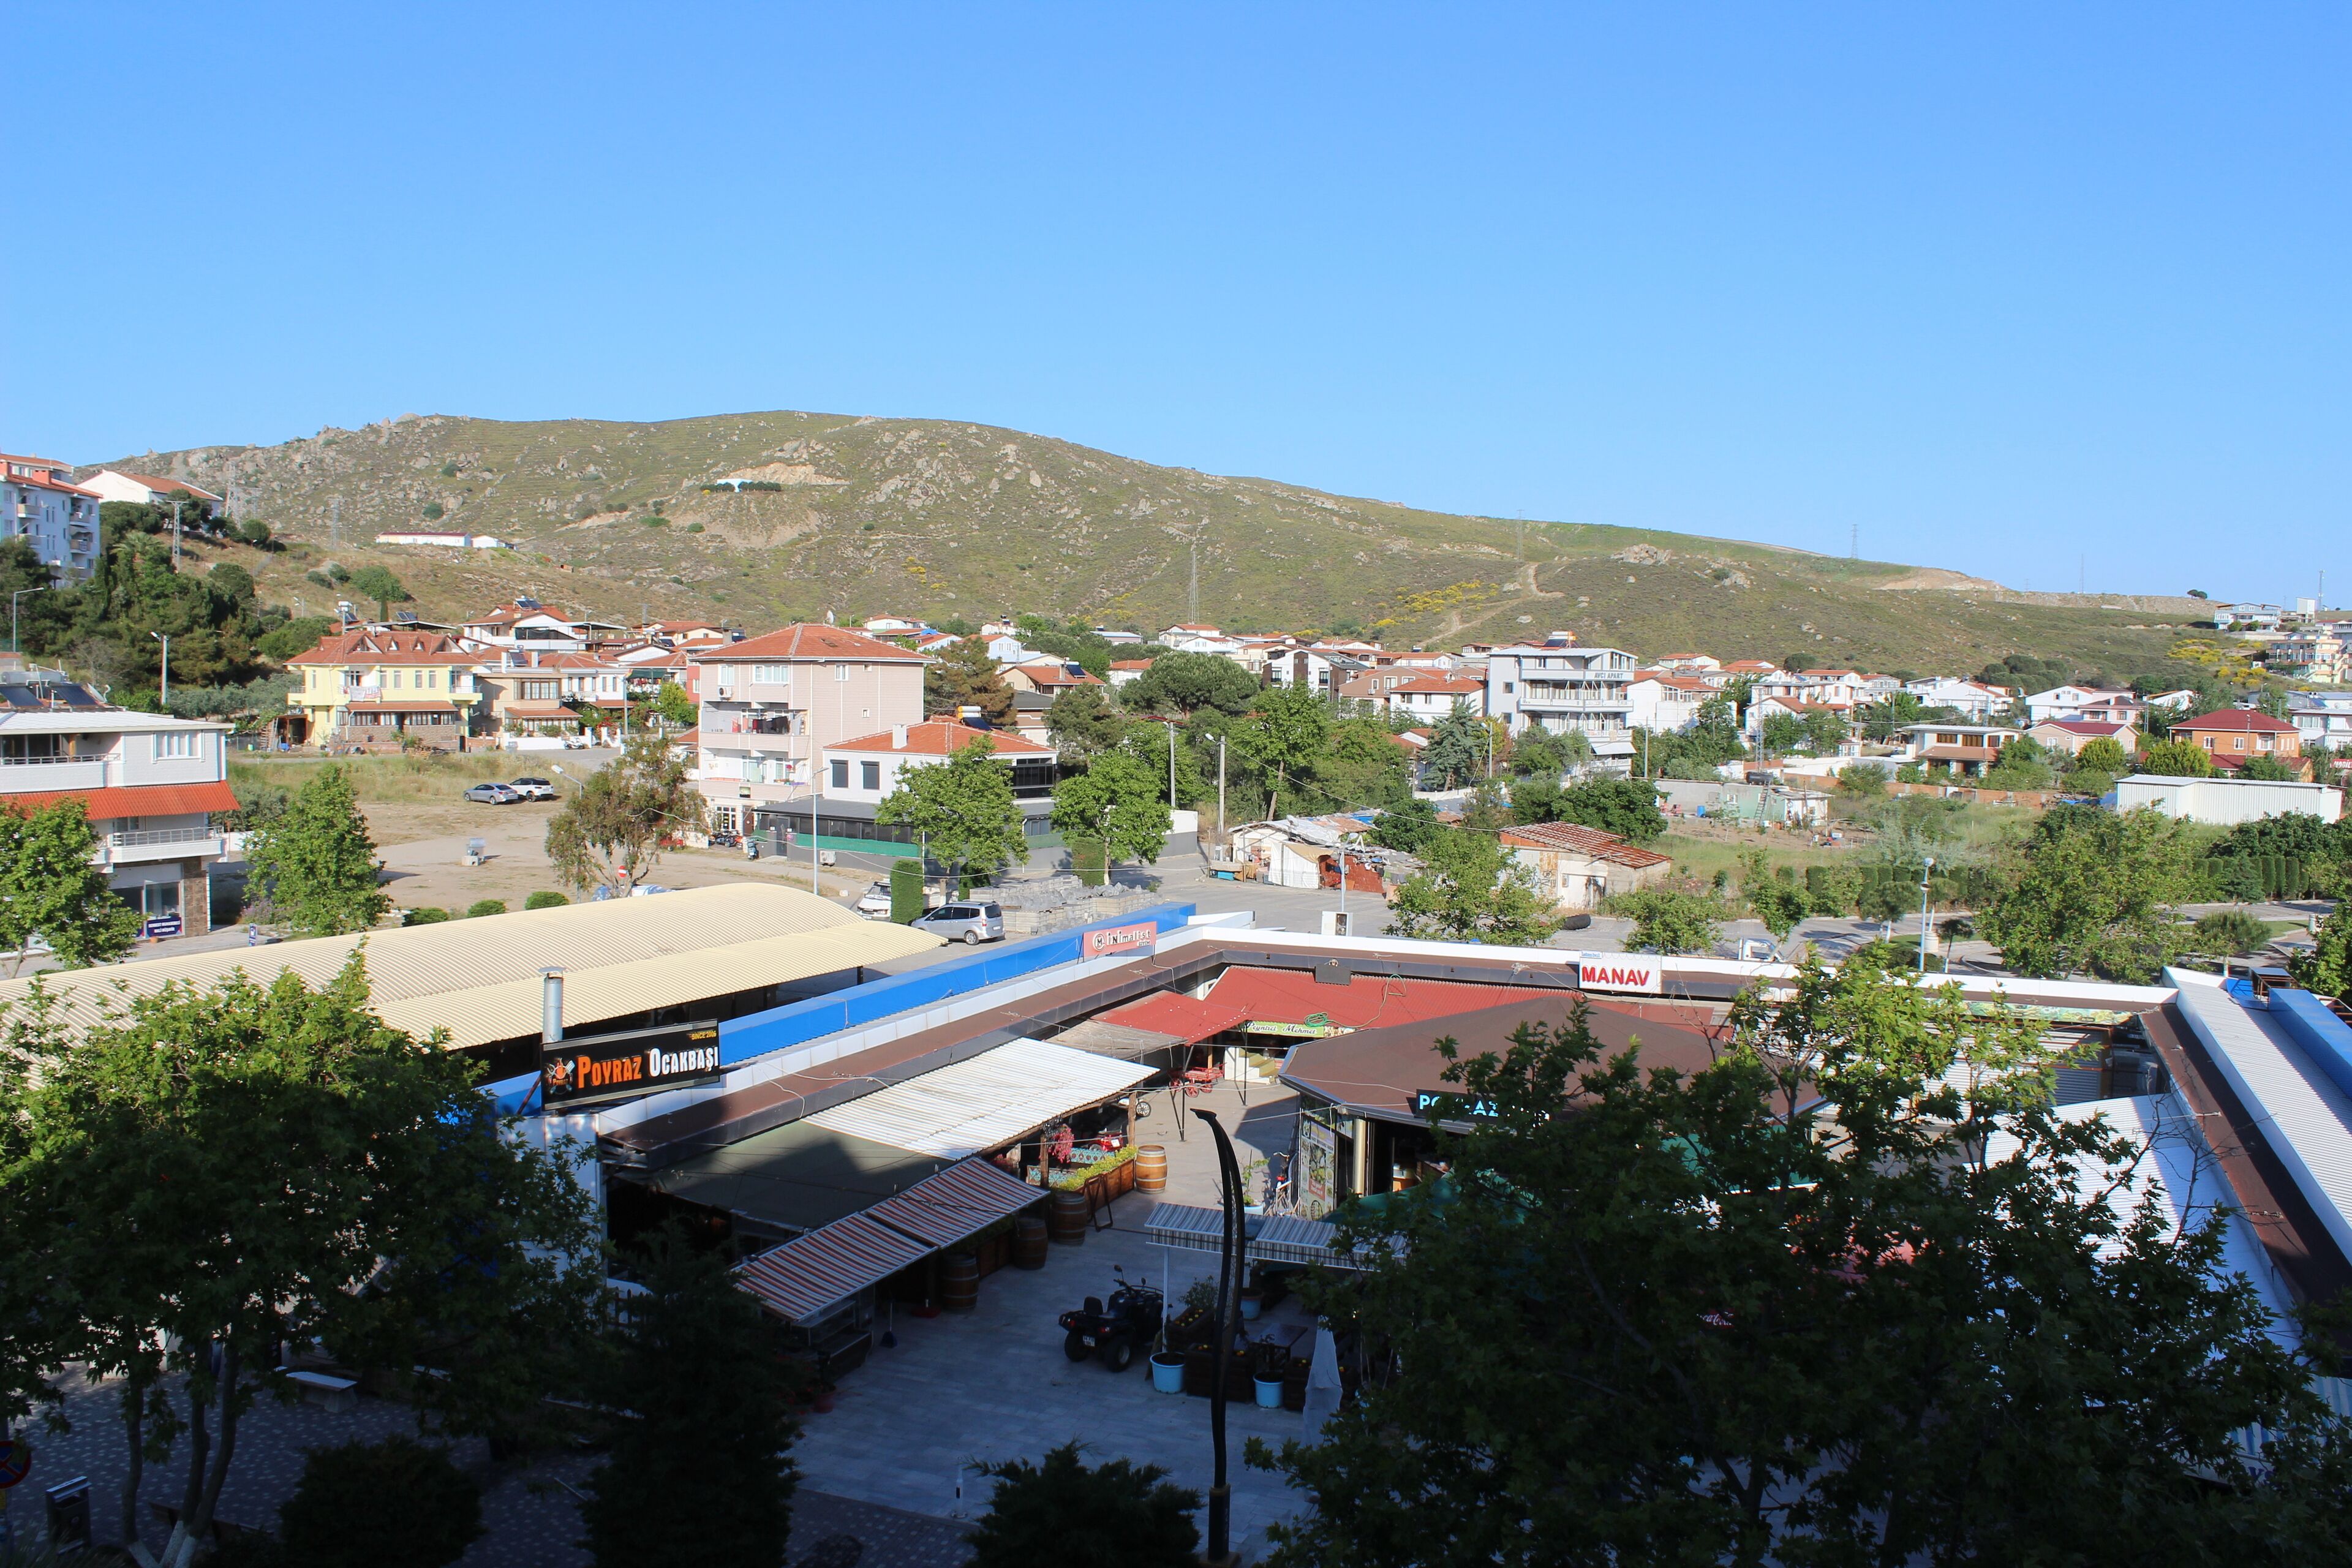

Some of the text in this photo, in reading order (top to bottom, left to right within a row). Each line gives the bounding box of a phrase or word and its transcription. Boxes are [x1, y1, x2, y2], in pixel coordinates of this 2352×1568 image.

[1581, 966, 1650, 986] MANAV
[1283, 1024, 1316, 1035] Mehmet
[577, 1047, 719, 1088] POYRAZ OCAKBAŞI
